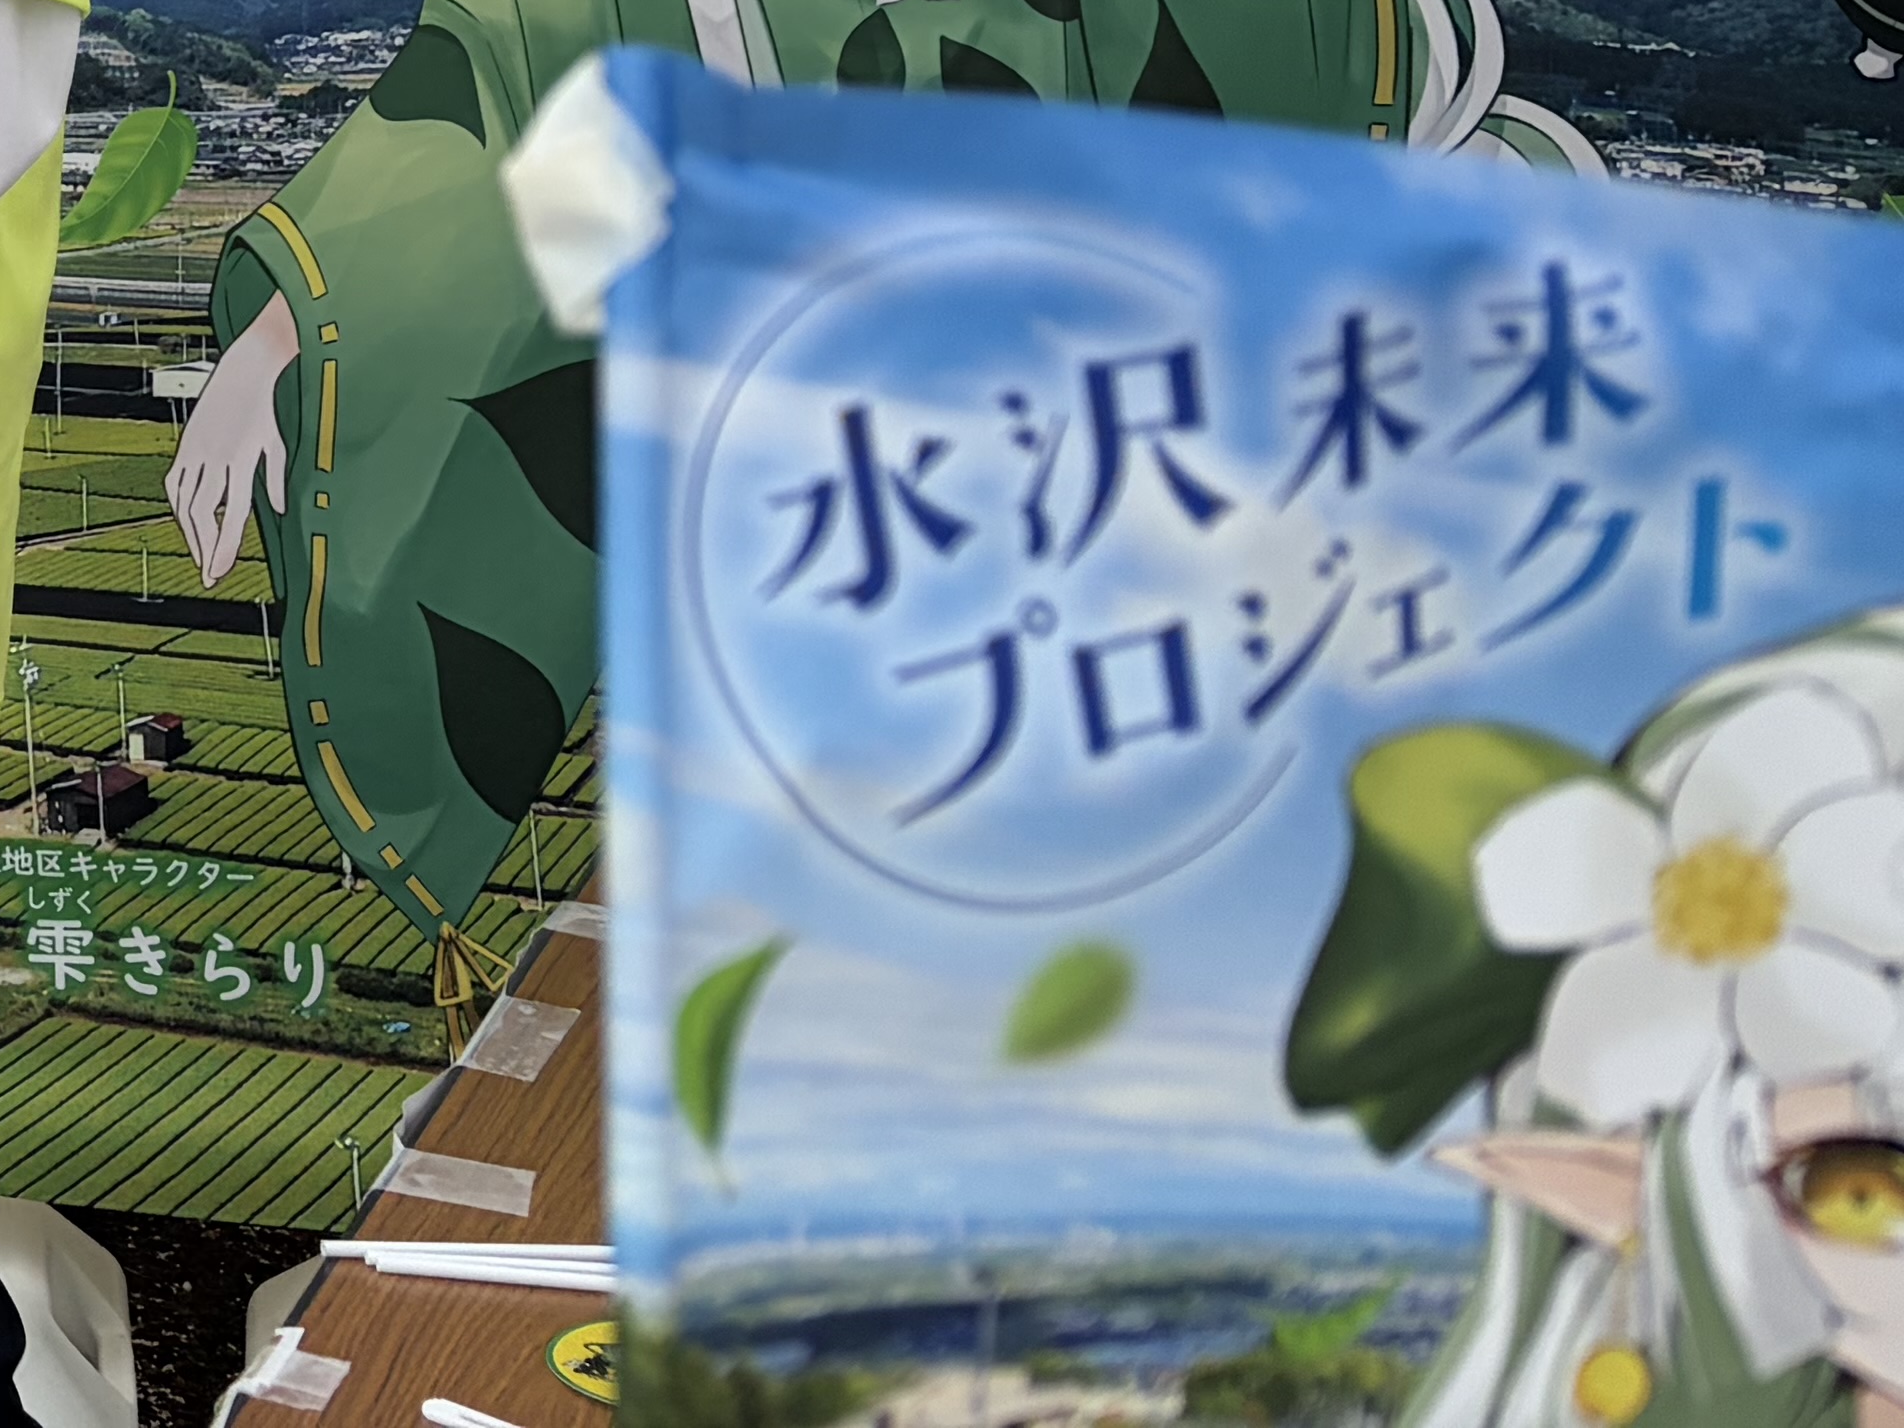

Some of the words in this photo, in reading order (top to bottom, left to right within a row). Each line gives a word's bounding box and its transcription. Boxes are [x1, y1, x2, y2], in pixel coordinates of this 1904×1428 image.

[758, 260, 1650, 611] 水沢未来
[890, 475, 1789, 829] プロジェクト
[27, 919, 325, 1009] 雫きらり
[28, 886, 91, 914] しずく
